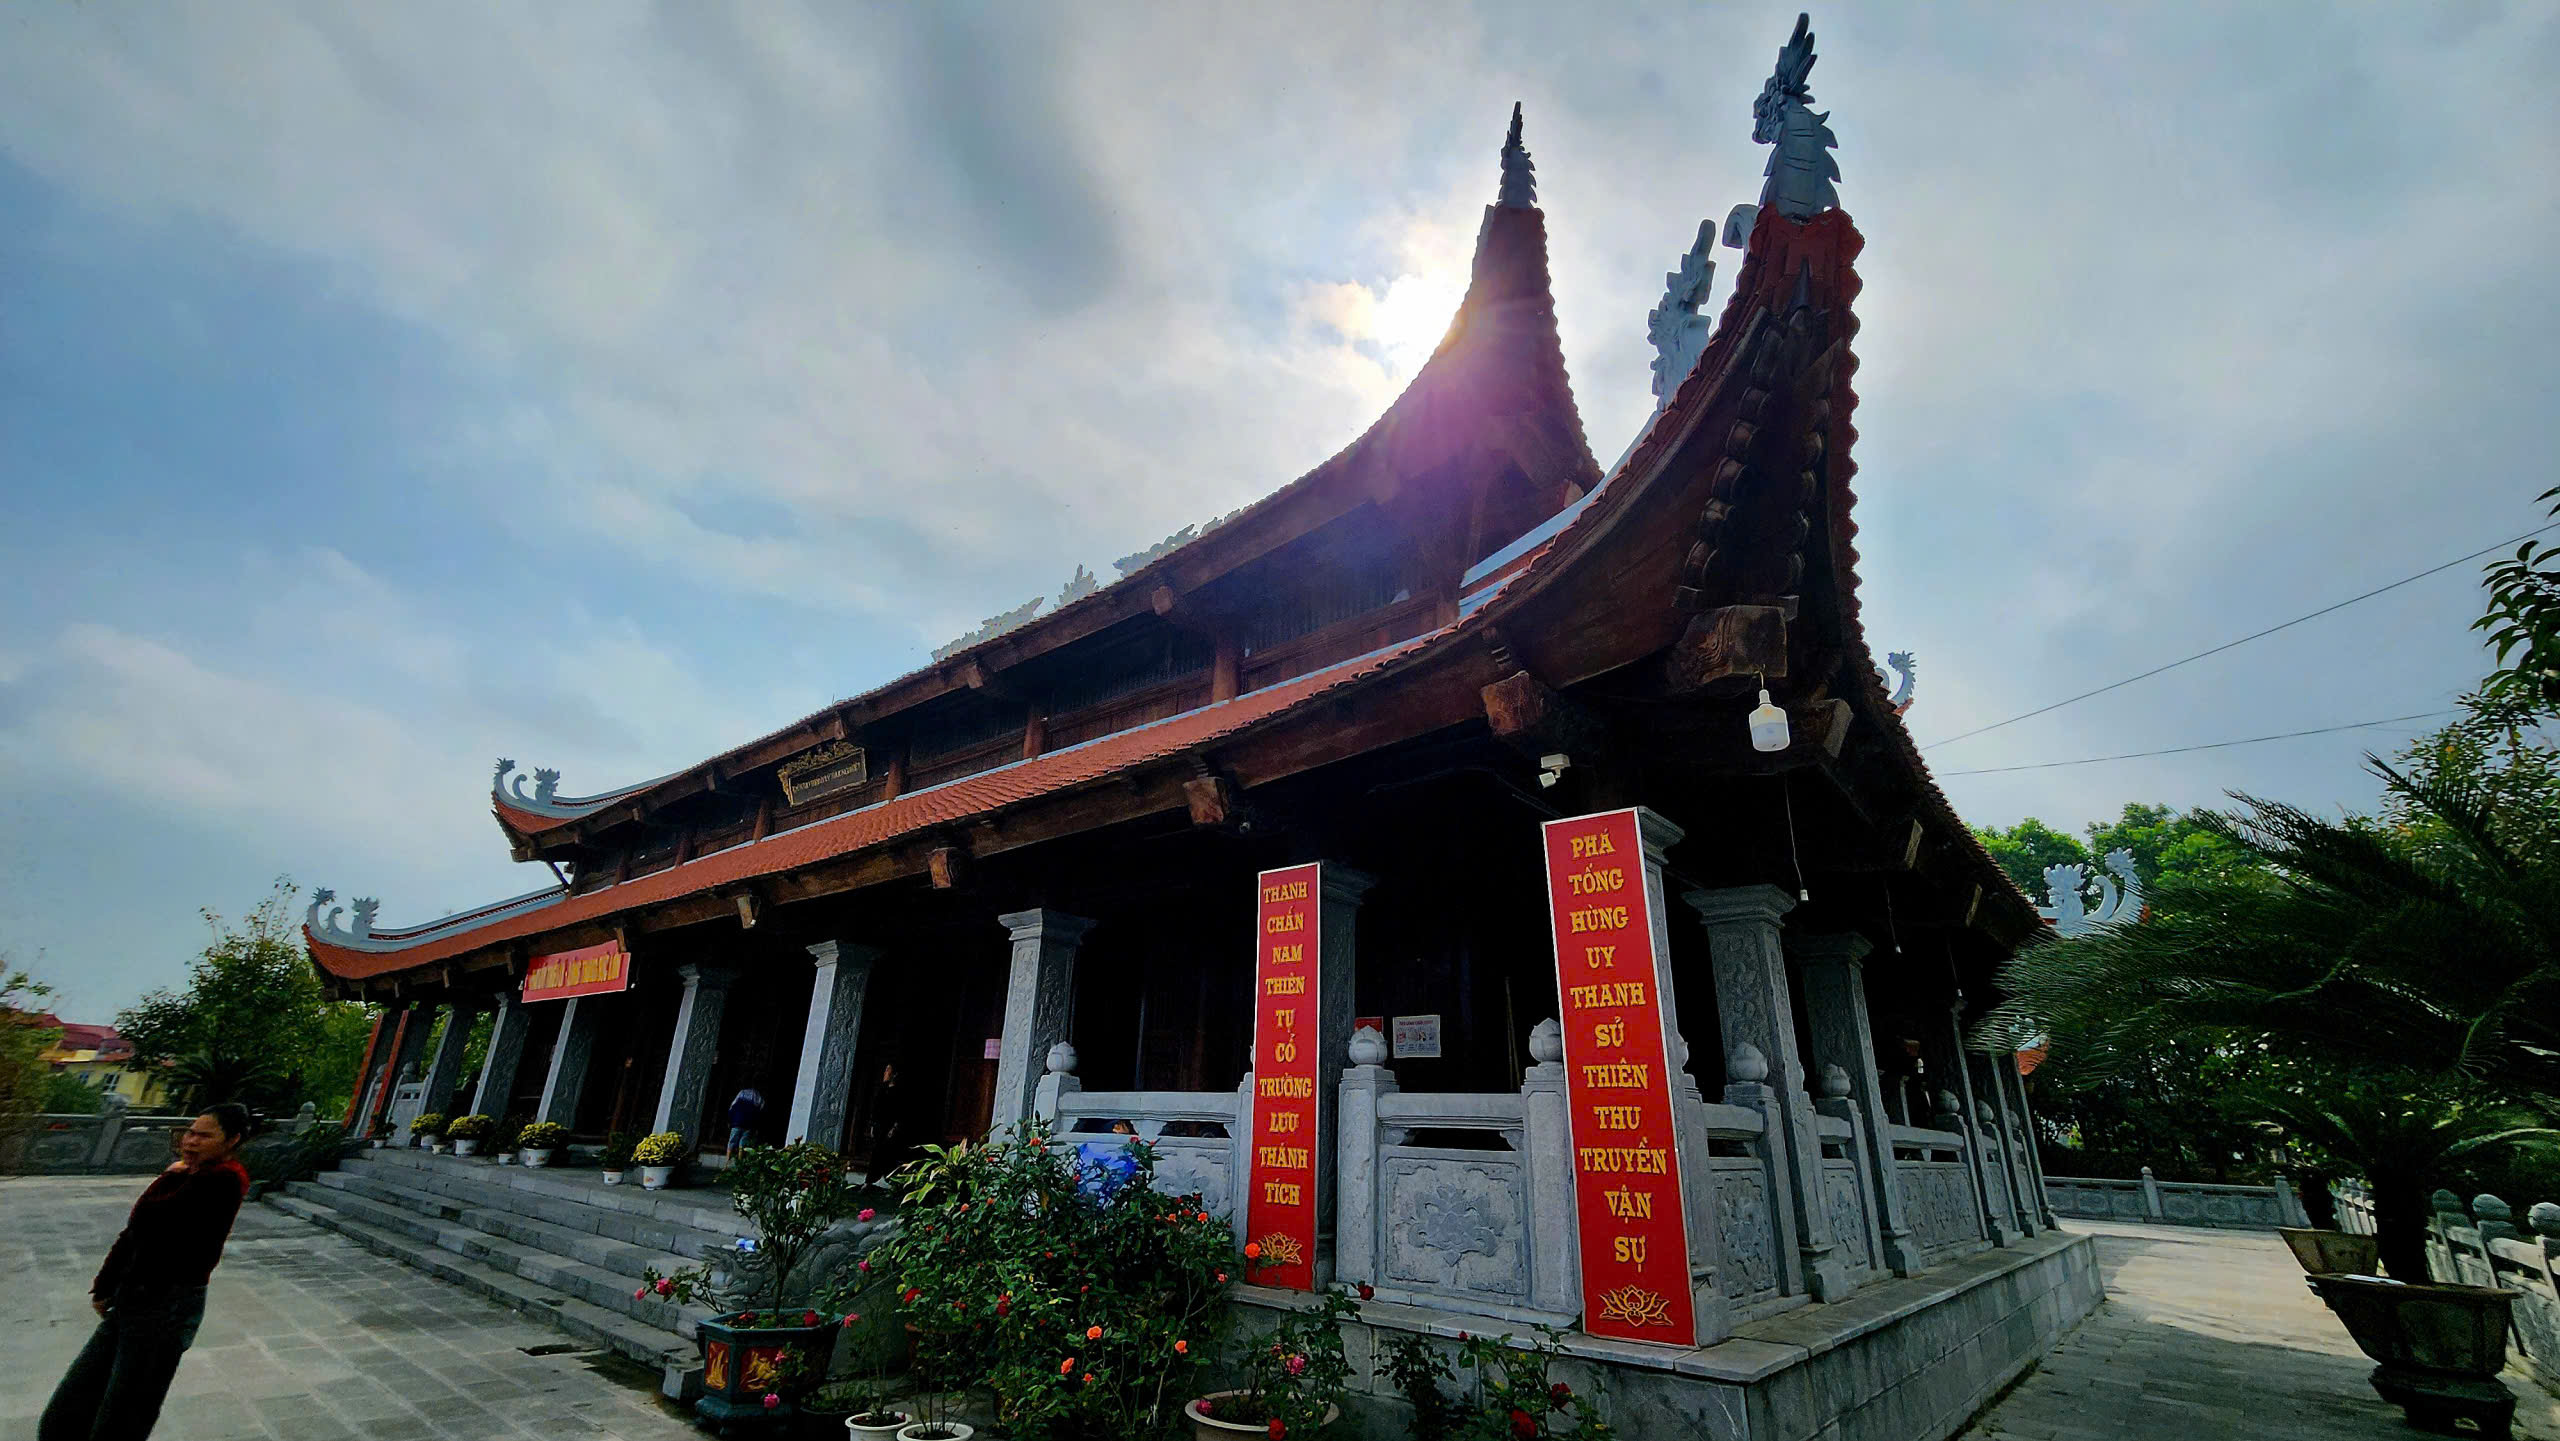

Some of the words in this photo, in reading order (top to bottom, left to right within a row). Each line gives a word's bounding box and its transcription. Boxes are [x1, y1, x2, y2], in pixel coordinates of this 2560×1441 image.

[1569, 828, 1616, 858] PHÁ
[1262, 881, 1308, 904] THANH
[1567, 863, 1625, 896] TỐNG
[1569, 904, 1629, 934] HÙNG
[1271, 943, 1304, 965] NAM
[1585, 946, 1616, 969] UY
[1569, 983, 1647, 1009] THANH
[1582, 1058, 1649, 1090] THIÊN
[1593, 1106, 1642, 1130] THU
[1258, 1143, 1309, 1170] THÁNH
[1579, 1136, 1667, 1176] TRUYỀN
[1264, 1178, 1301, 1206] TÍCH
[1604, 1185, 1652, 1224] VẬN
